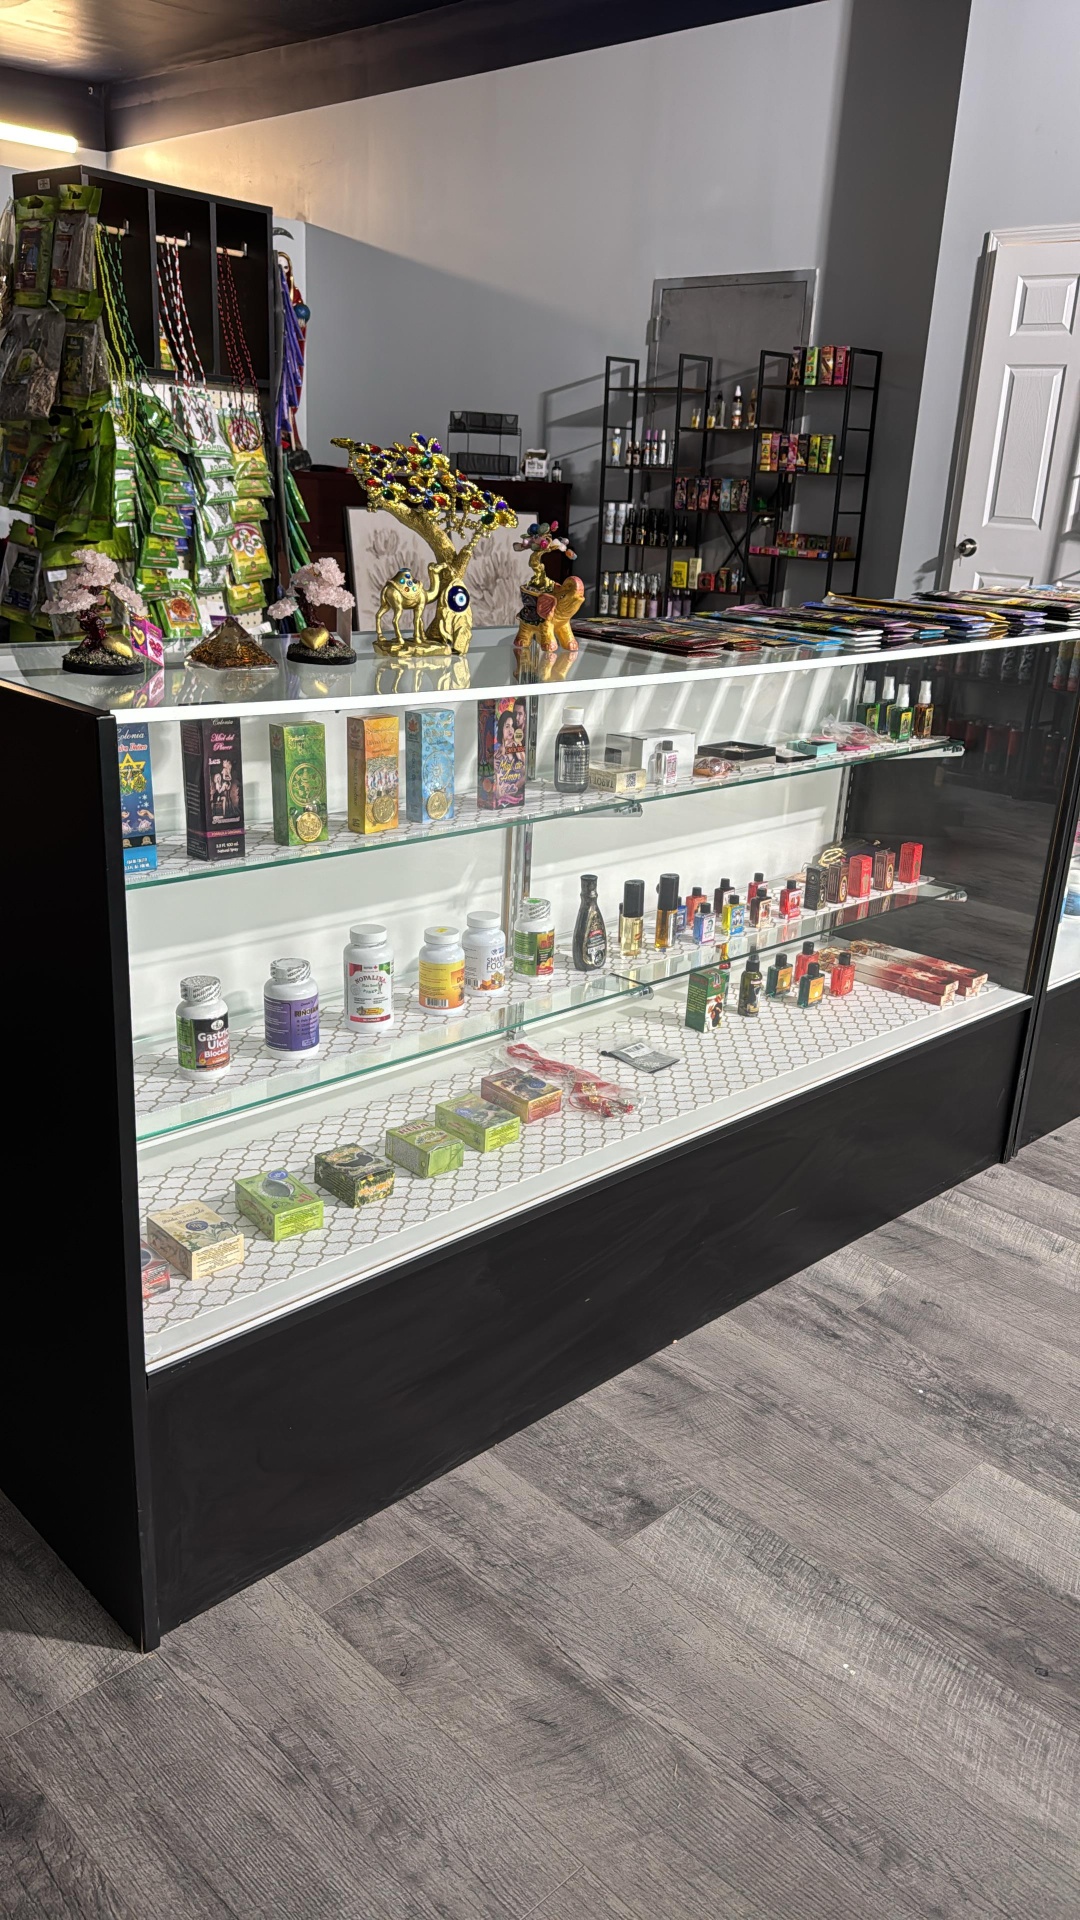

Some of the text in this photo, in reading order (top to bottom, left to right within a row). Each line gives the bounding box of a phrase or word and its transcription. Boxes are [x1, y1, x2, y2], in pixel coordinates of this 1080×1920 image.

[202, 443, 227, 451] ROMERO
[210, 463, 231, 471] ROMERO
[213, 490, 234, 498] ROMERO
